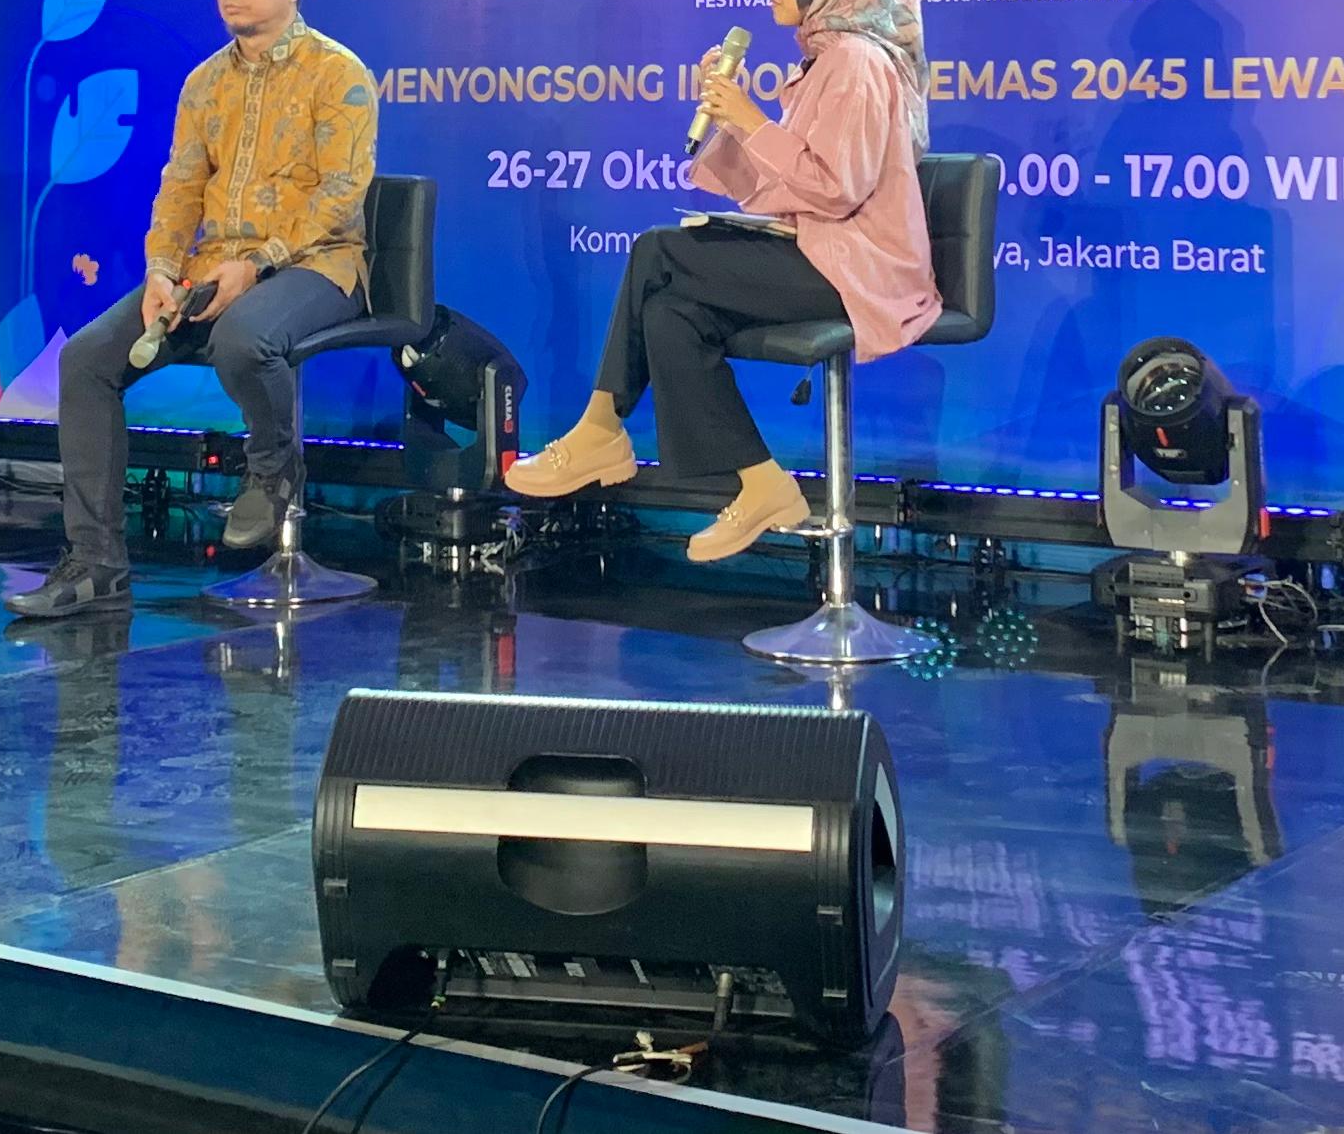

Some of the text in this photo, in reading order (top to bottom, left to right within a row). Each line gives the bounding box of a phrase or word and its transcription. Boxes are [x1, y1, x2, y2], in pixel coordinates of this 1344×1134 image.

[366, 65, 665, 103] MENYONGSONG
[929, 59, 1058, 100] EMAS
[1071, 58, 1188, 100] 2045
[487, 150, 591, 189] 26-27
[1123, 154, 1250, 200] 17.00
[1038, 236, 1160, 270] Jakarta
[1172, 239, 1266, 274] Barat
